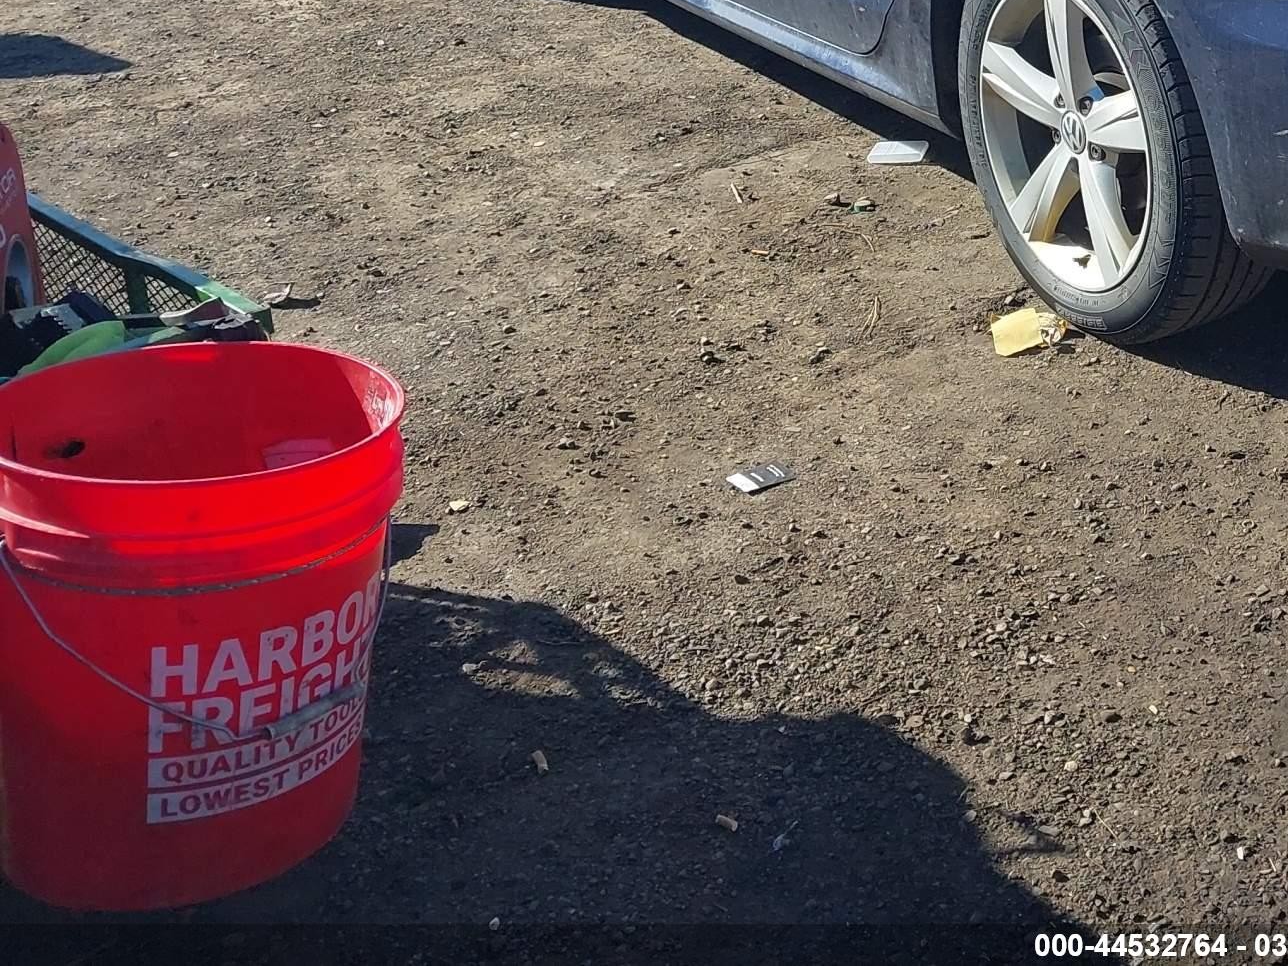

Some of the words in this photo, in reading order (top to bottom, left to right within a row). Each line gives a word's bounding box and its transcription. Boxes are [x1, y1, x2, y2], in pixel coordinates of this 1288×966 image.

[151, 571, 380, 697] HARBOR
[162, 728, 305, 782] QUALITY
[160, 768, 290, 818] LOWEST
